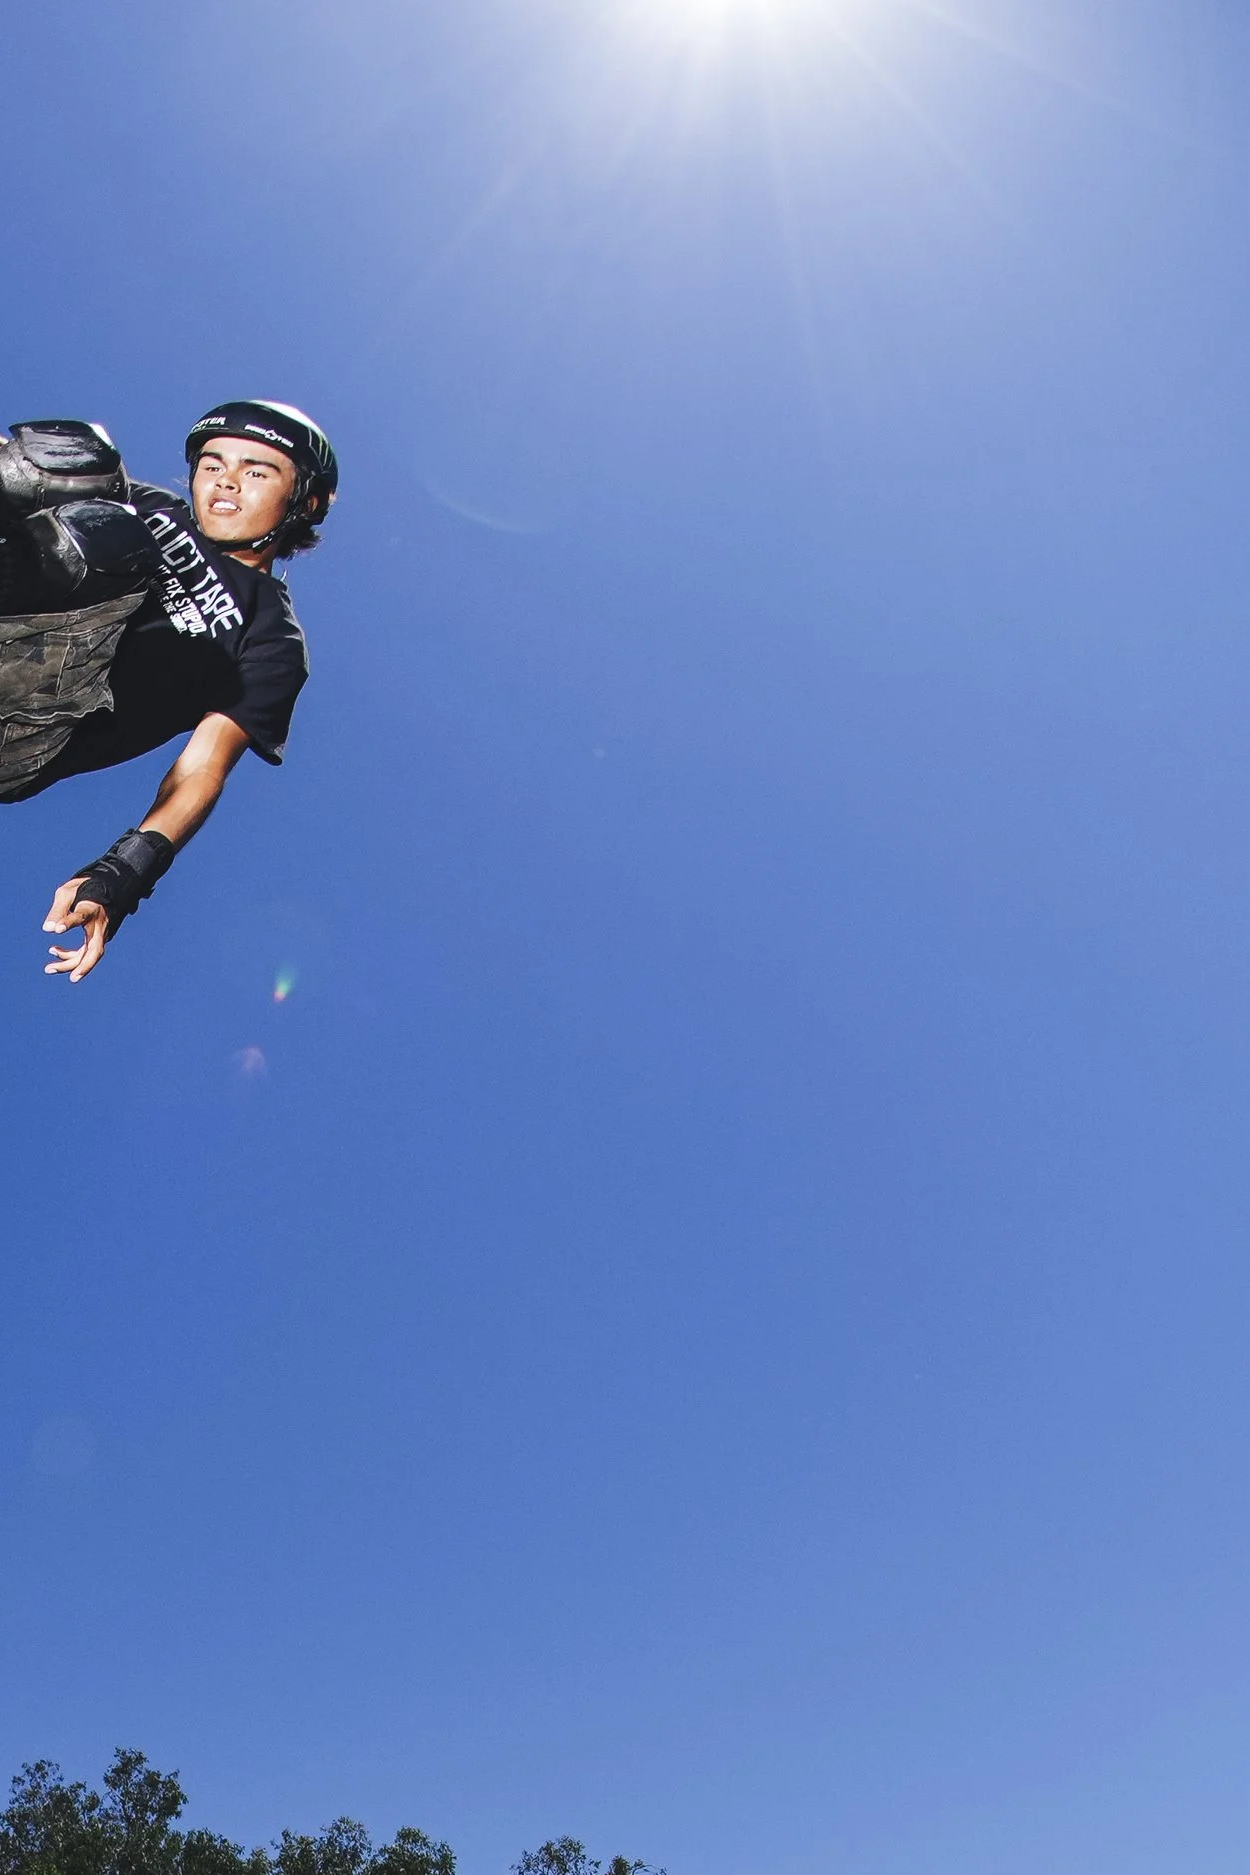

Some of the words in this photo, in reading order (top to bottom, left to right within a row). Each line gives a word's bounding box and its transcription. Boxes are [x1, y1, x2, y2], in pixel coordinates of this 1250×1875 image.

[165, 577, 186, 599] FIX
[190, 566, 244, 638] TAPE
[174, 597, 207, 637] STUPID,
